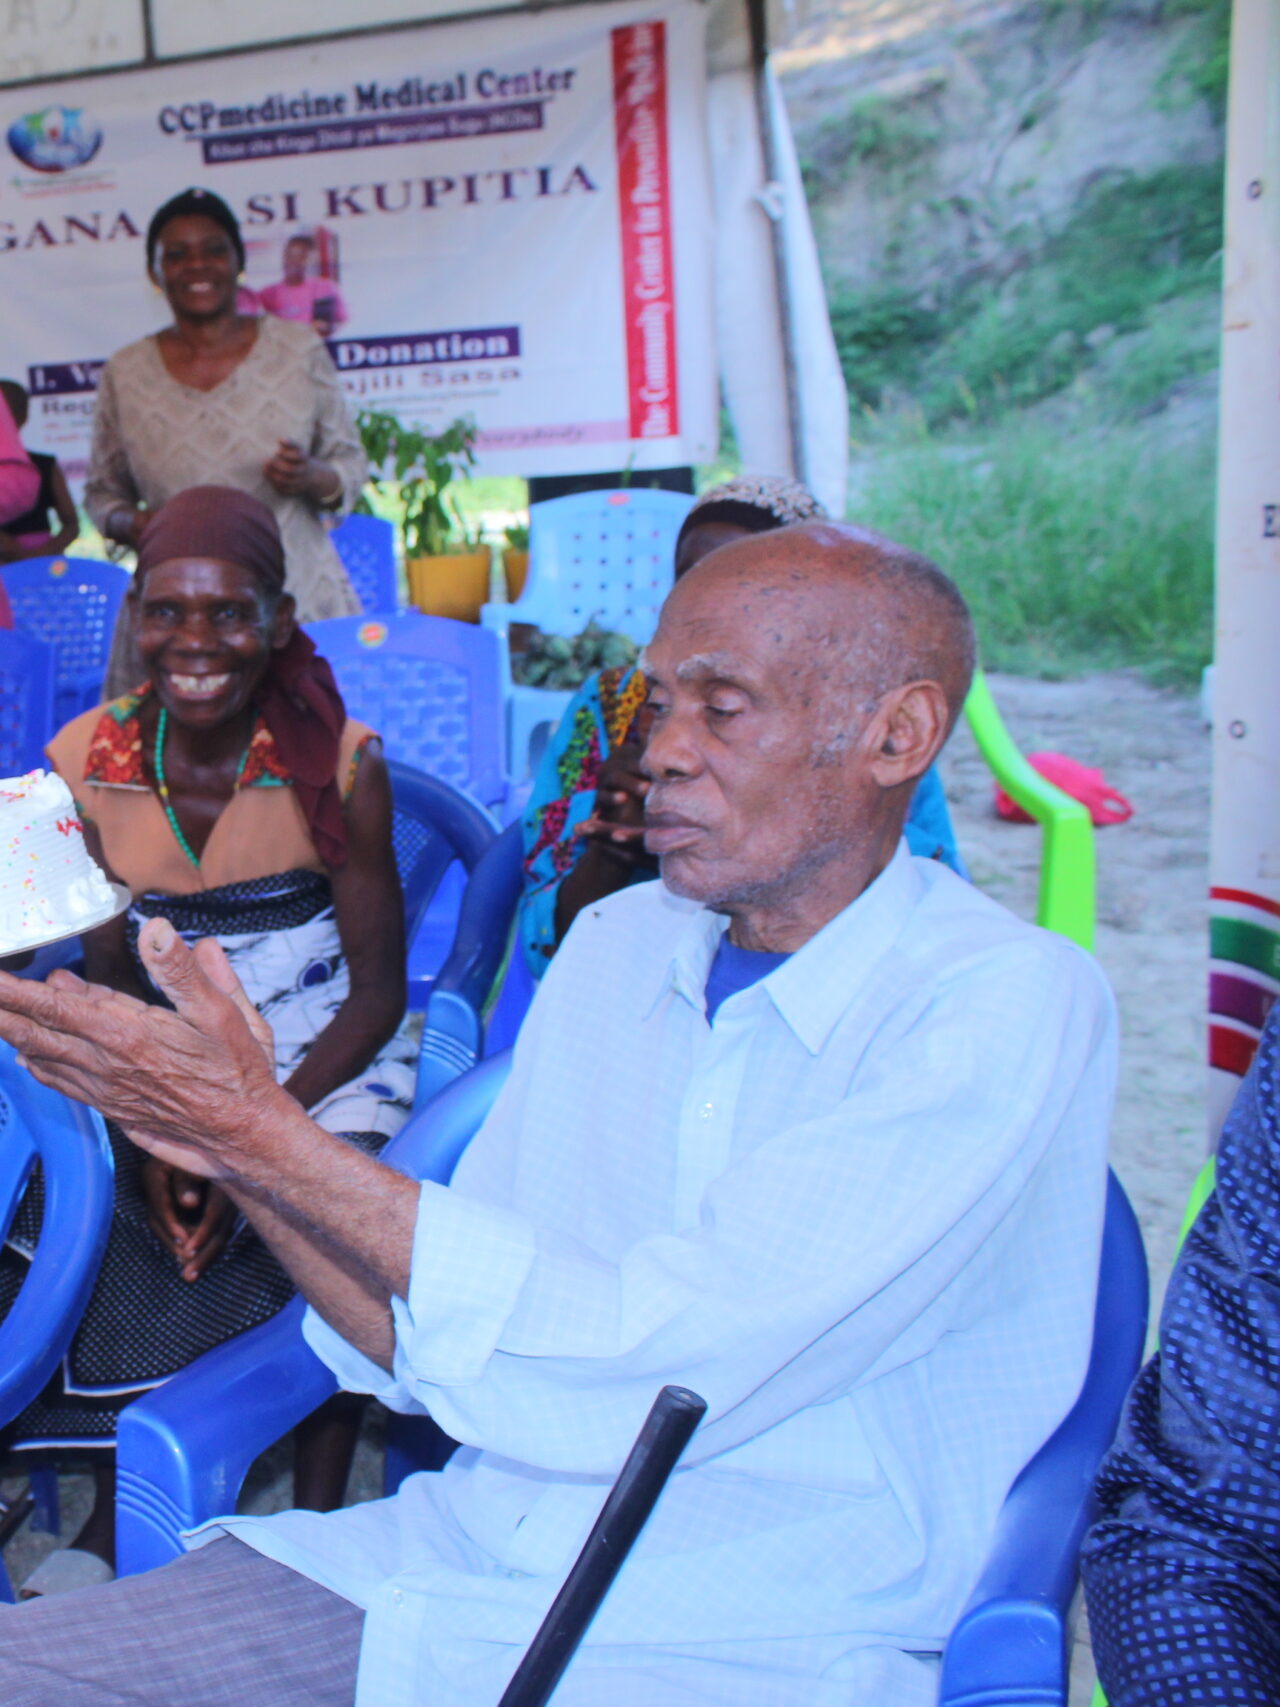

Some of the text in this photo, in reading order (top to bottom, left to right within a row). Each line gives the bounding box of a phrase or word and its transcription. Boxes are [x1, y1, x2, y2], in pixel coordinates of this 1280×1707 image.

[158, 67, 576, 134] CCPmedicine Medical Center
[246, 189, 298, 225] SI
[325, 163, 597, 219] KUPITIA
[336, 333, 510, 369] Donation
[635, 301, 672, 403] Community
[640, 403, 670, 438] The
